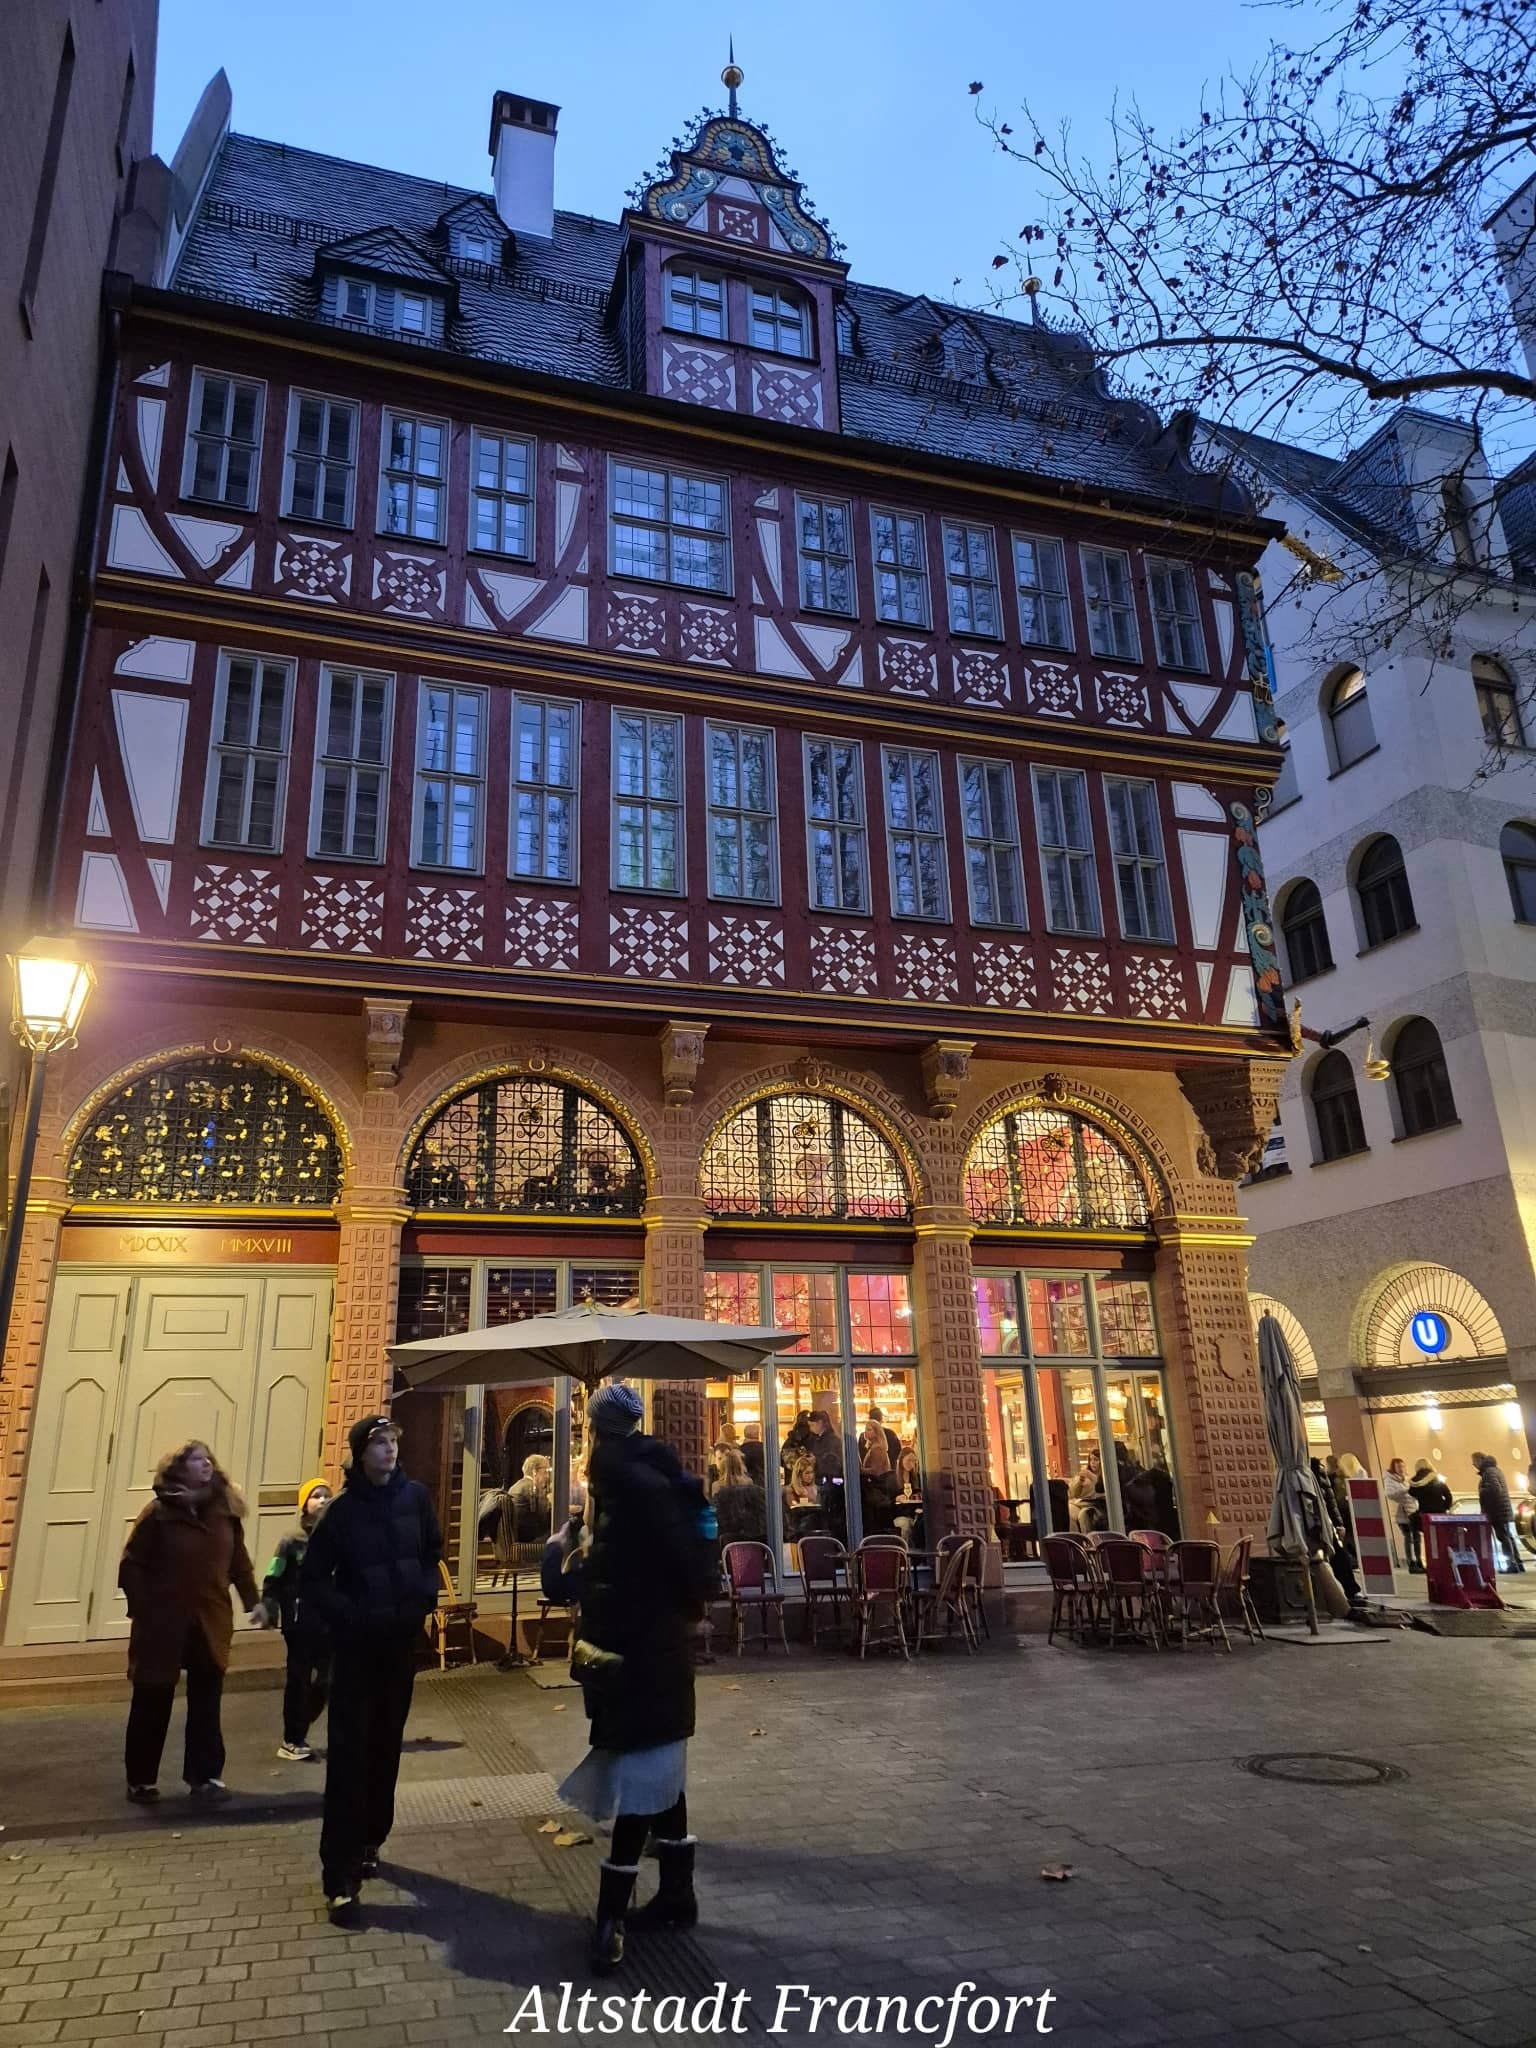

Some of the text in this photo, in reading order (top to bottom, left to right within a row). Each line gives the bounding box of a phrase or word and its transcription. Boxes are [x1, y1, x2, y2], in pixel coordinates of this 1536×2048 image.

[119, 1234, 292, 1254] MDCXIX MMXVIII
[1416, 1318, 1439, 1347] U
